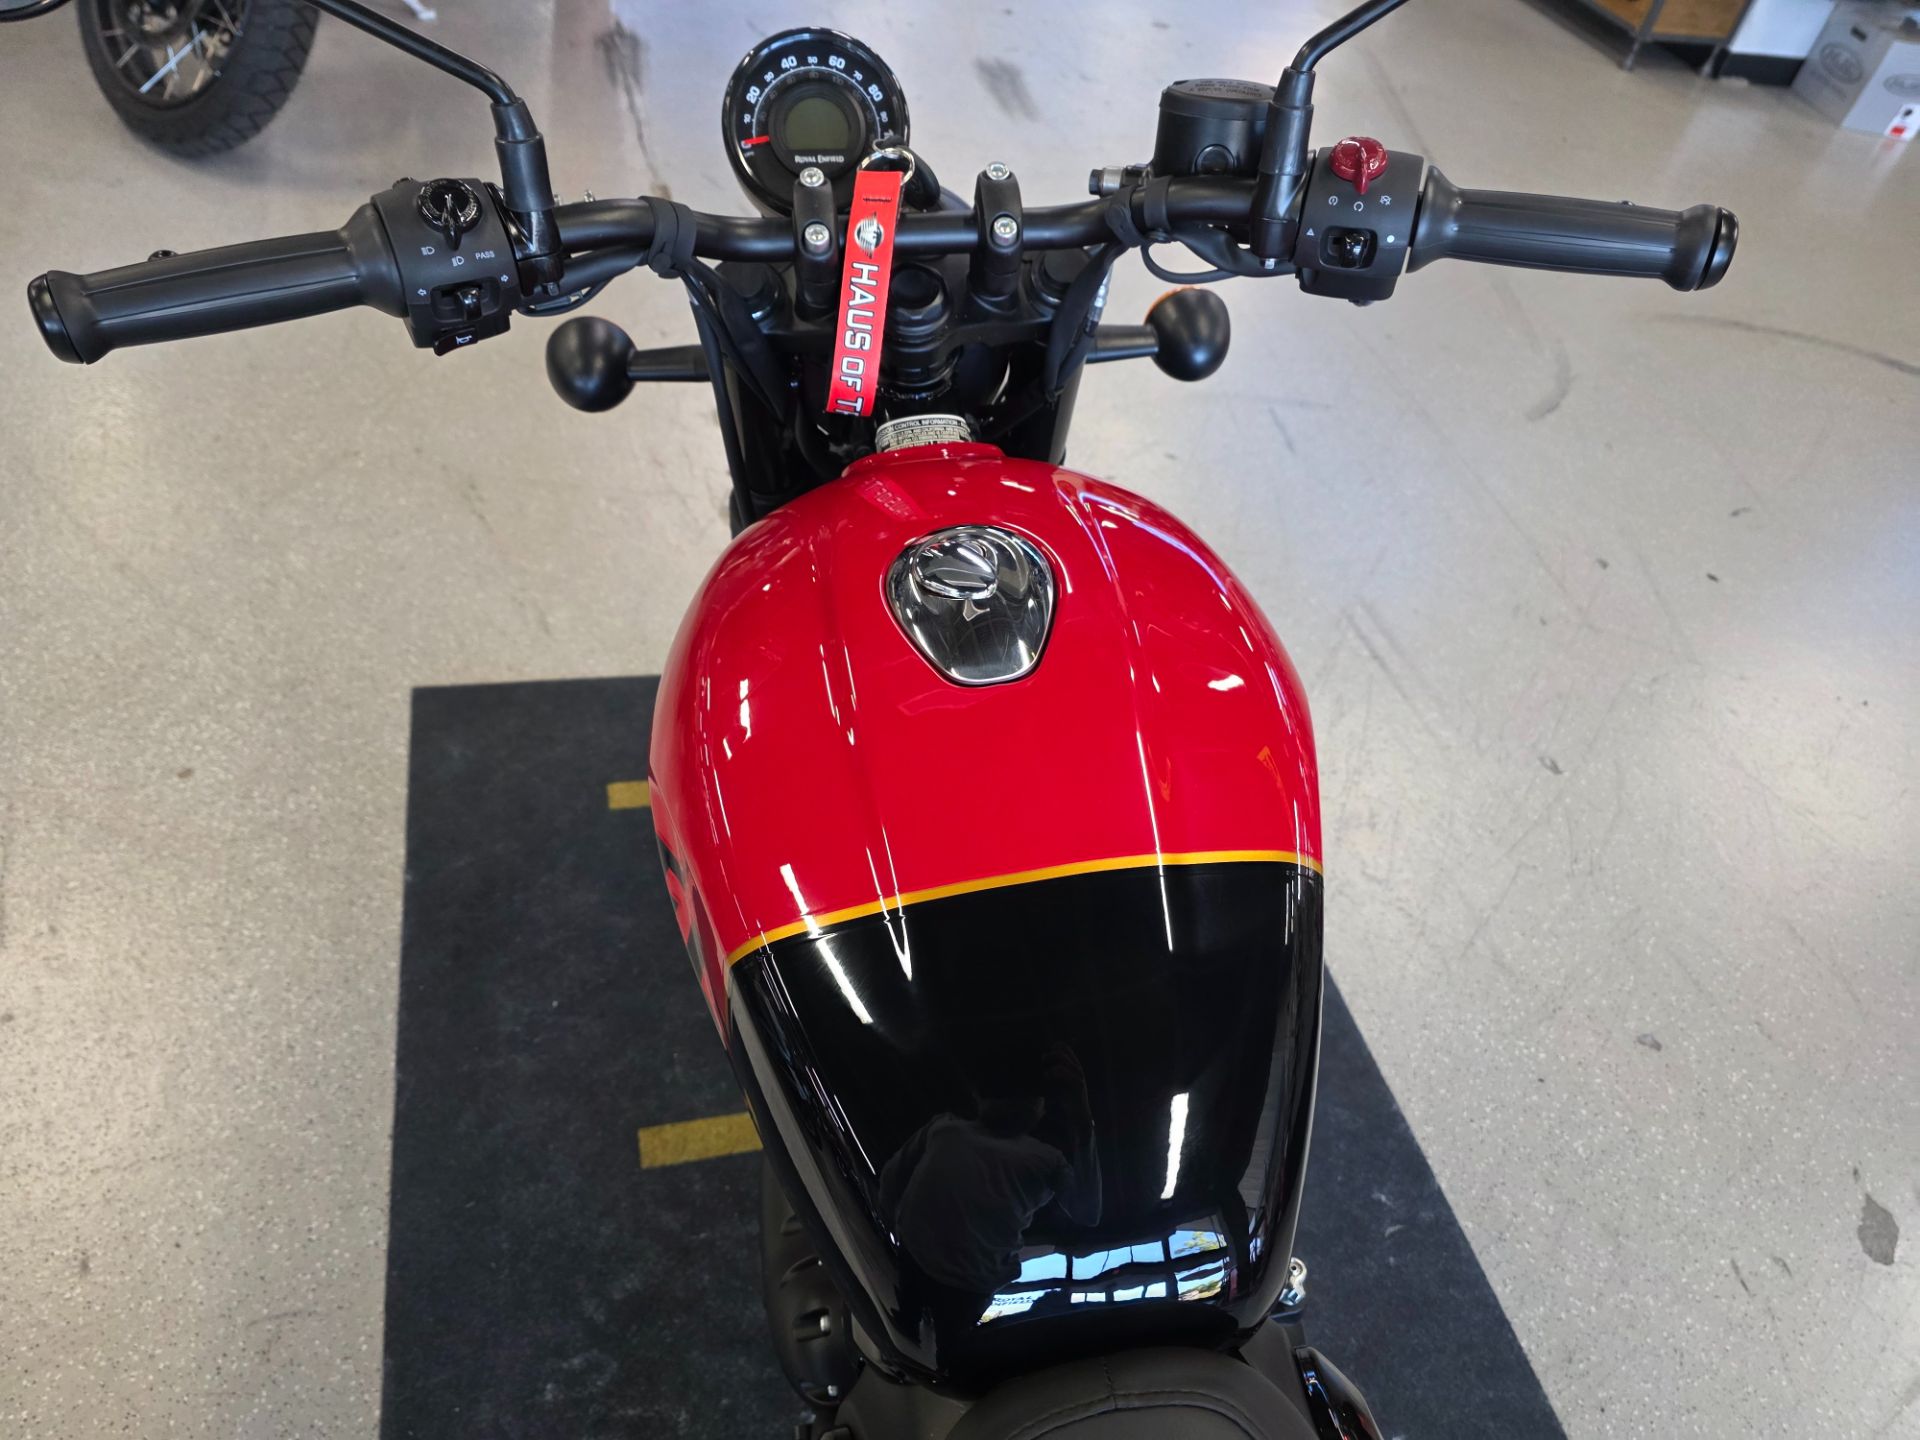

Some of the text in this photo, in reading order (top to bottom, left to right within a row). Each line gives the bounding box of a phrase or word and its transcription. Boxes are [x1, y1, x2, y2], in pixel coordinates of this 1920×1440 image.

[781, 56, 797, 69] 40
[807, 56, 818, 64] 50
[828, 56, 845, 69] 60
[764, 72, 775, 83] 30
[853, 71, 863, 81] 70
[746, 86, 760, 103] 20
[868, 84, 883, 102] 80
[743, 114, 751, 124] 10
[880, 111, 888, 123] 90
[475, 250, 495, 260] PASS
[845, 261, 879, 352] HAUS
[840, 355, 865, 392] OF
[894, 421, 921, 430] CONTROL
[921, 418, 957, 426] INFORMATION
